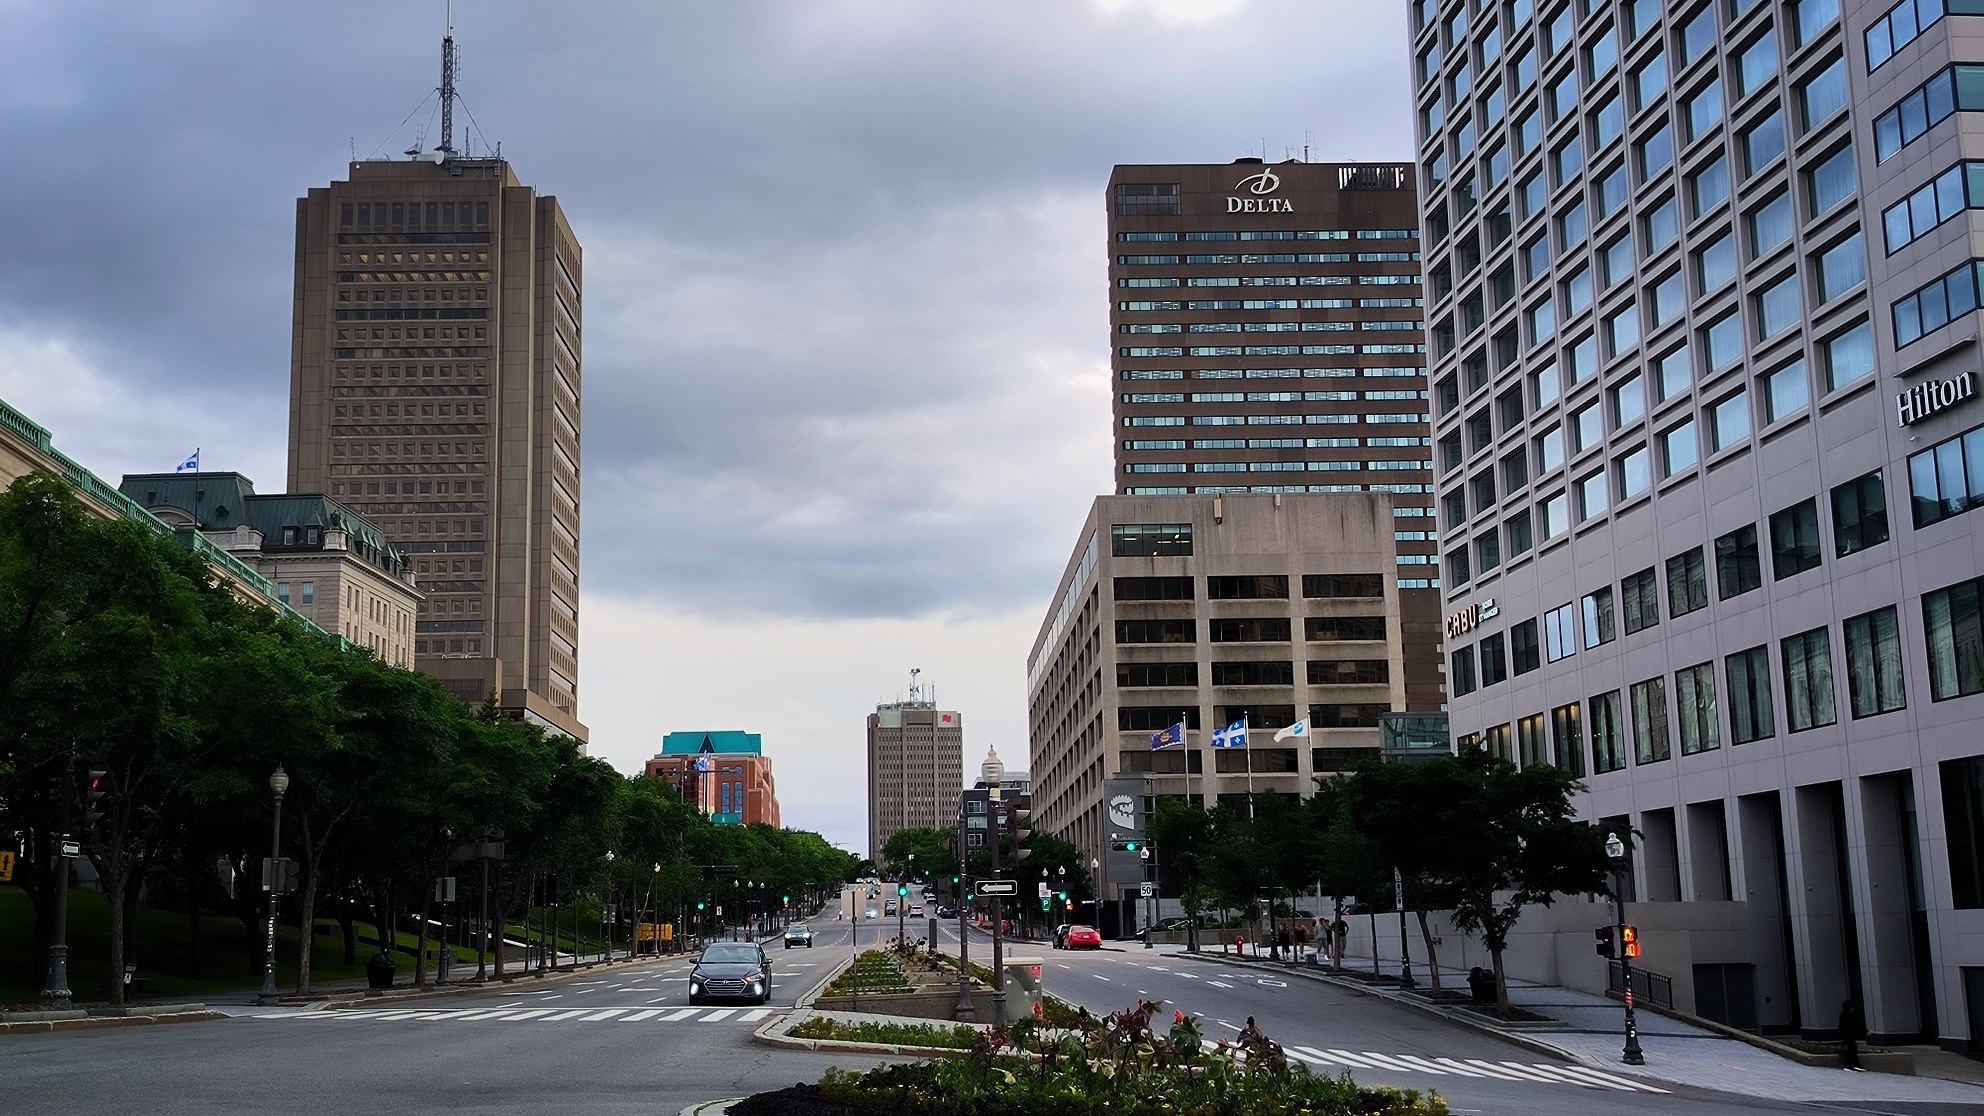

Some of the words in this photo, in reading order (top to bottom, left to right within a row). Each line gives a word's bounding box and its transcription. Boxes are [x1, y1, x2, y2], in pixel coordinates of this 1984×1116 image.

[1226, 196, 1294, 213] DELTA
[1895, 371, 1973, 428] Hilton
[1445, 603, 1477, 639] CABU
[1141, 886, 1151, 895] 50
